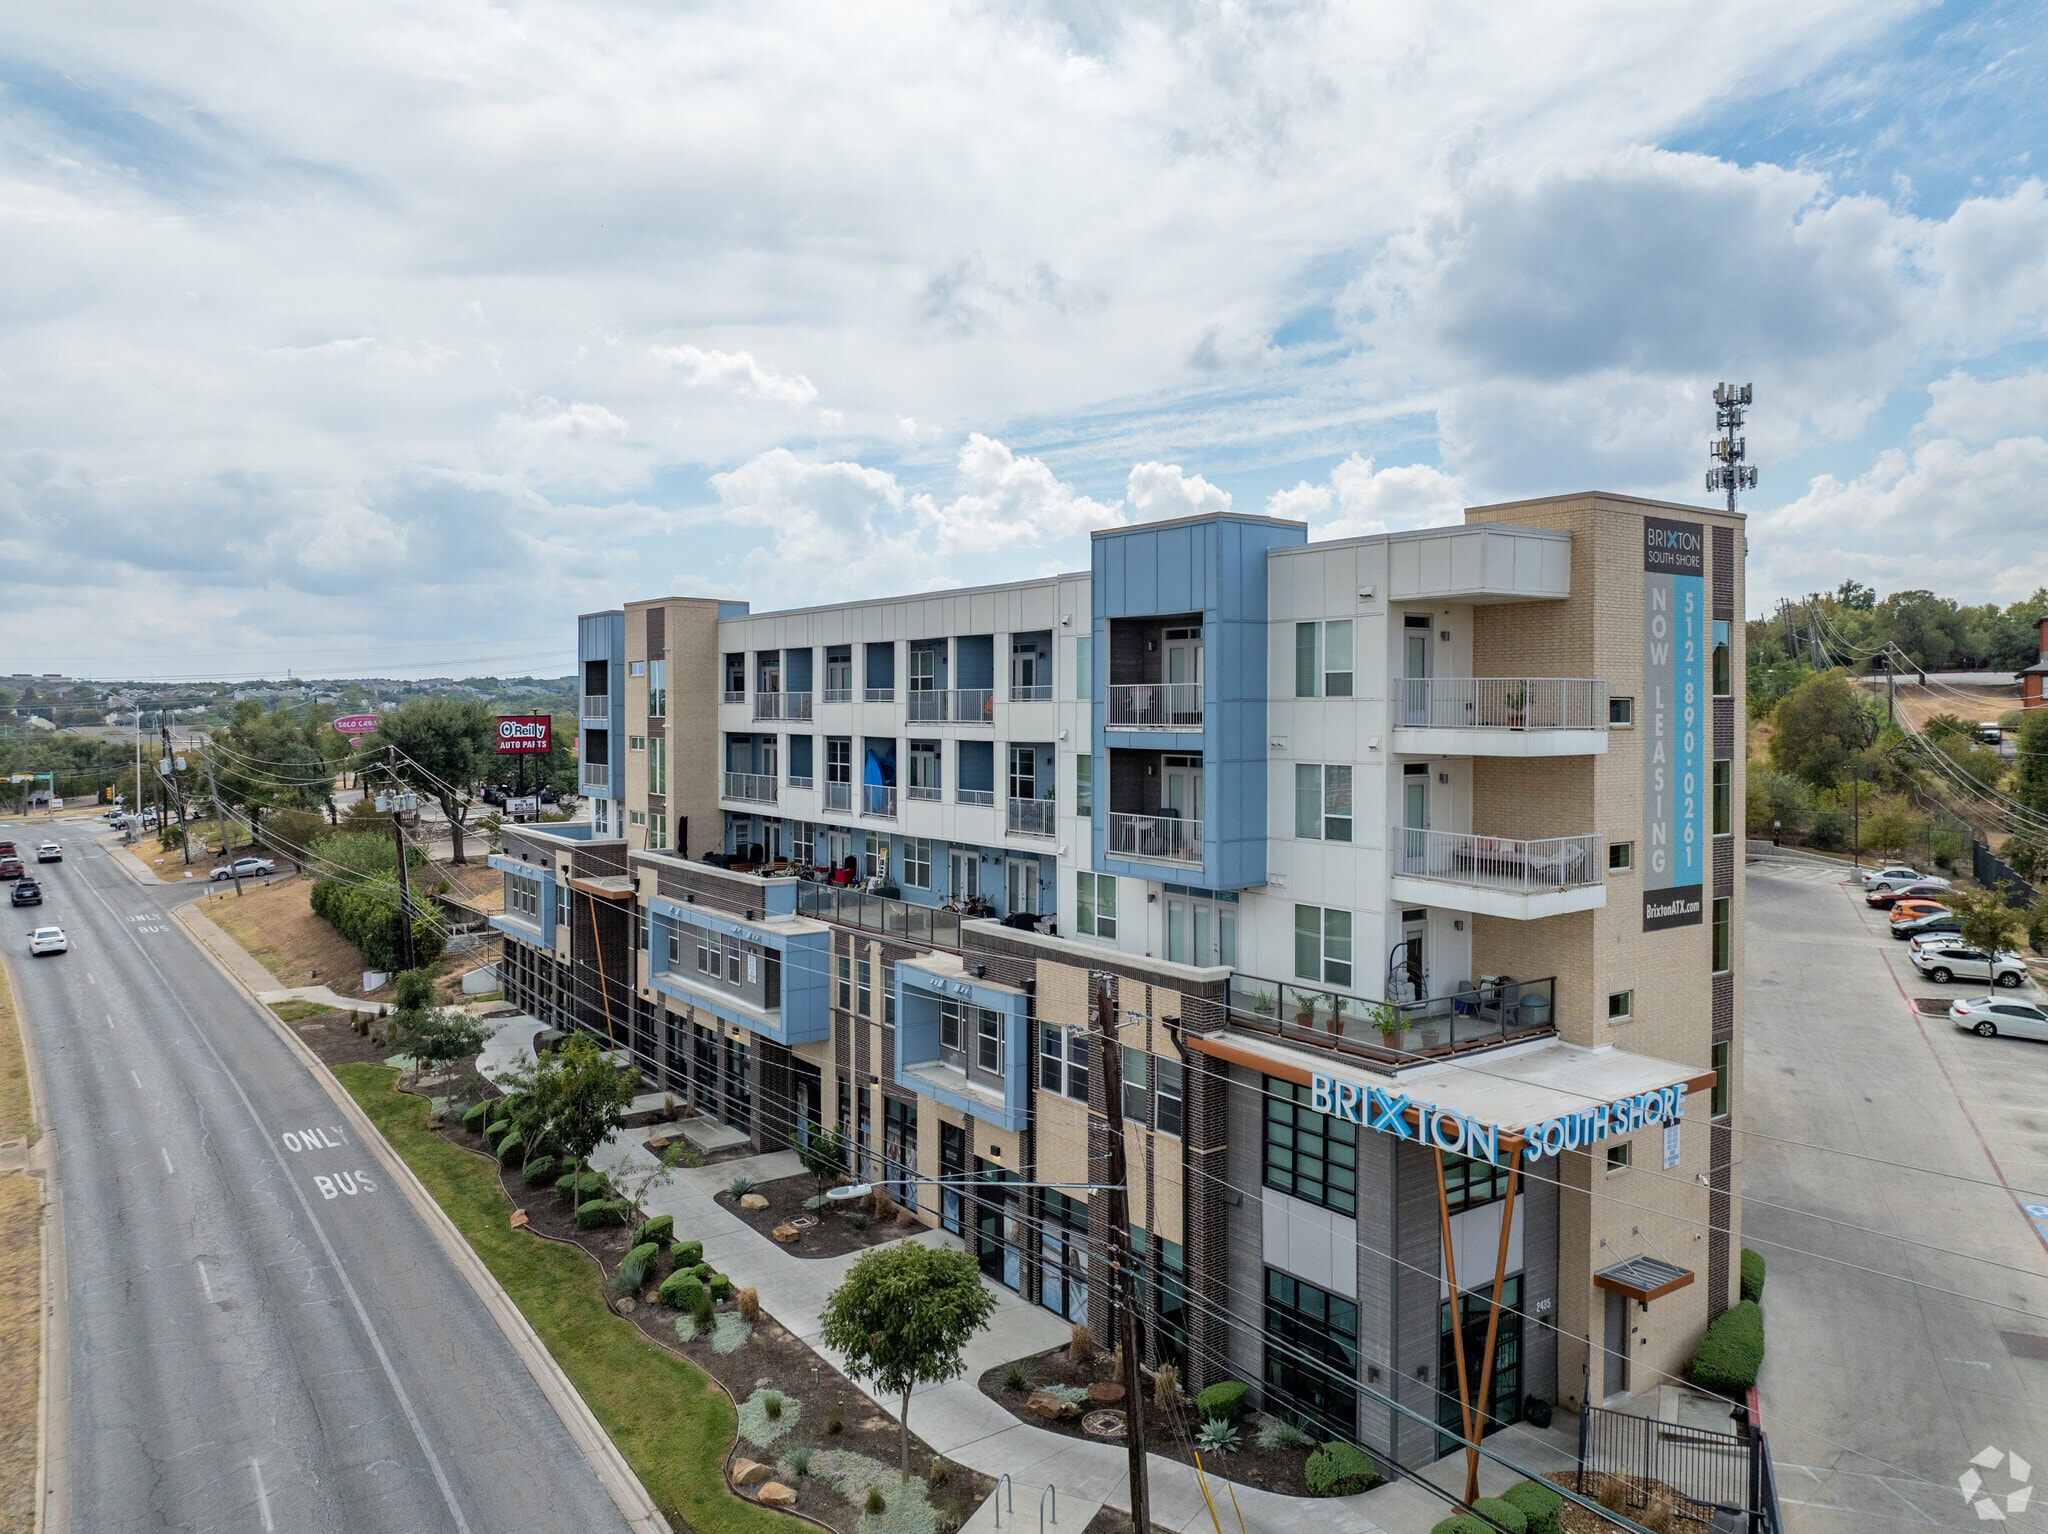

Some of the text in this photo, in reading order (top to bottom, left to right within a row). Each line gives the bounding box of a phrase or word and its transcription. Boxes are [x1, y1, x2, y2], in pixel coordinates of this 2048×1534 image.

[1647, 528, 1700, 551] BRIXTON
[1648, 550, 1700, 568] SOUTH SHORE
[500, 721, 546, 738] O'Reily
[1650, 587, 1669, 873] NOW LEASING
[500, 741, 520, 749] AUTO
[126, 913, 162, 922] ONLY
[1646, 899, 1700, 919] BrixtonATX.com
[138, 924, 170, 933] BUS
[1311, 1070, 1499, 1167] BRIXTON
[1522, 1104, 1610, 1162] SOUTH
[1611, 1083, 1688, 1136] SHORE
[282, 1125, 351, 1153] ONLY
[313, 1169, 379, 1200] BUS
[1536, 1297, 1551, 1313] 2435
